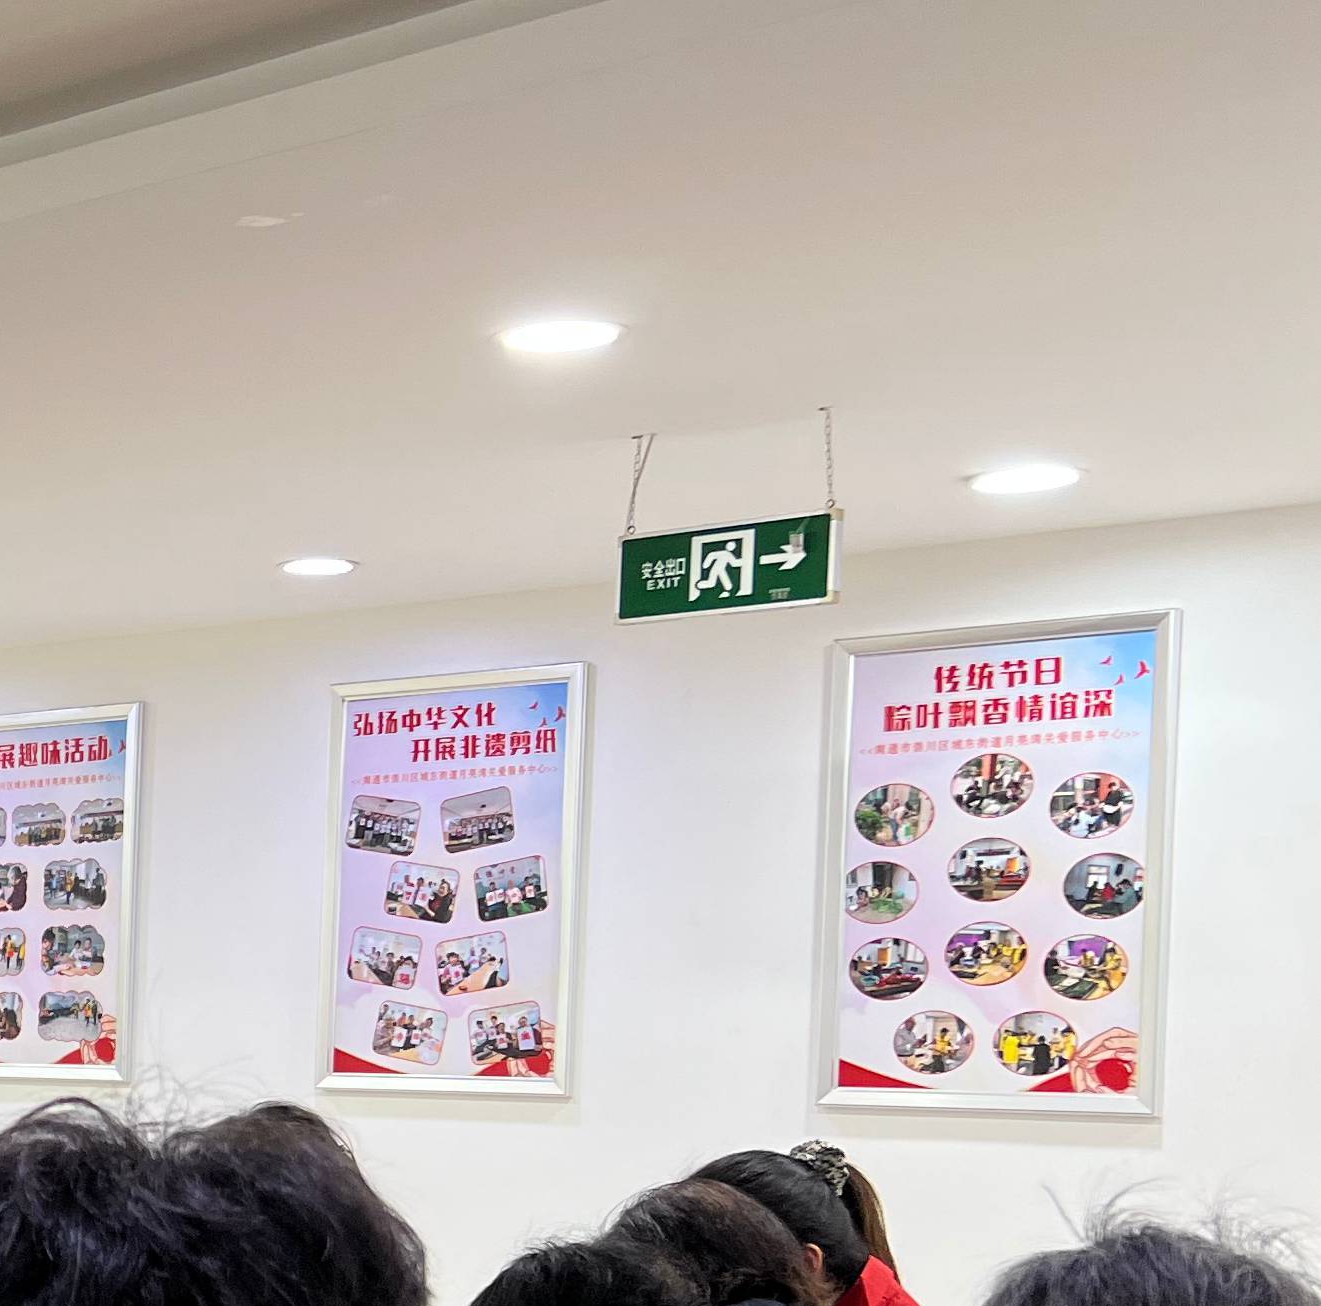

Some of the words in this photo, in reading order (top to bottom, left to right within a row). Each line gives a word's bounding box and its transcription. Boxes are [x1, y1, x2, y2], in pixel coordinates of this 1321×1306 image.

[641, 557, 686, 579] 安全出口
[646, 577, 681, 591] EXIT
[934, 657, 1062, 694] 传统节日
[353, 702, 497, 737] 弘扬中华文化
[882, 689, 1115, 732] 粽叶飘香情谊深
[410, 728, 558, 762] 开展非遗剪纸
